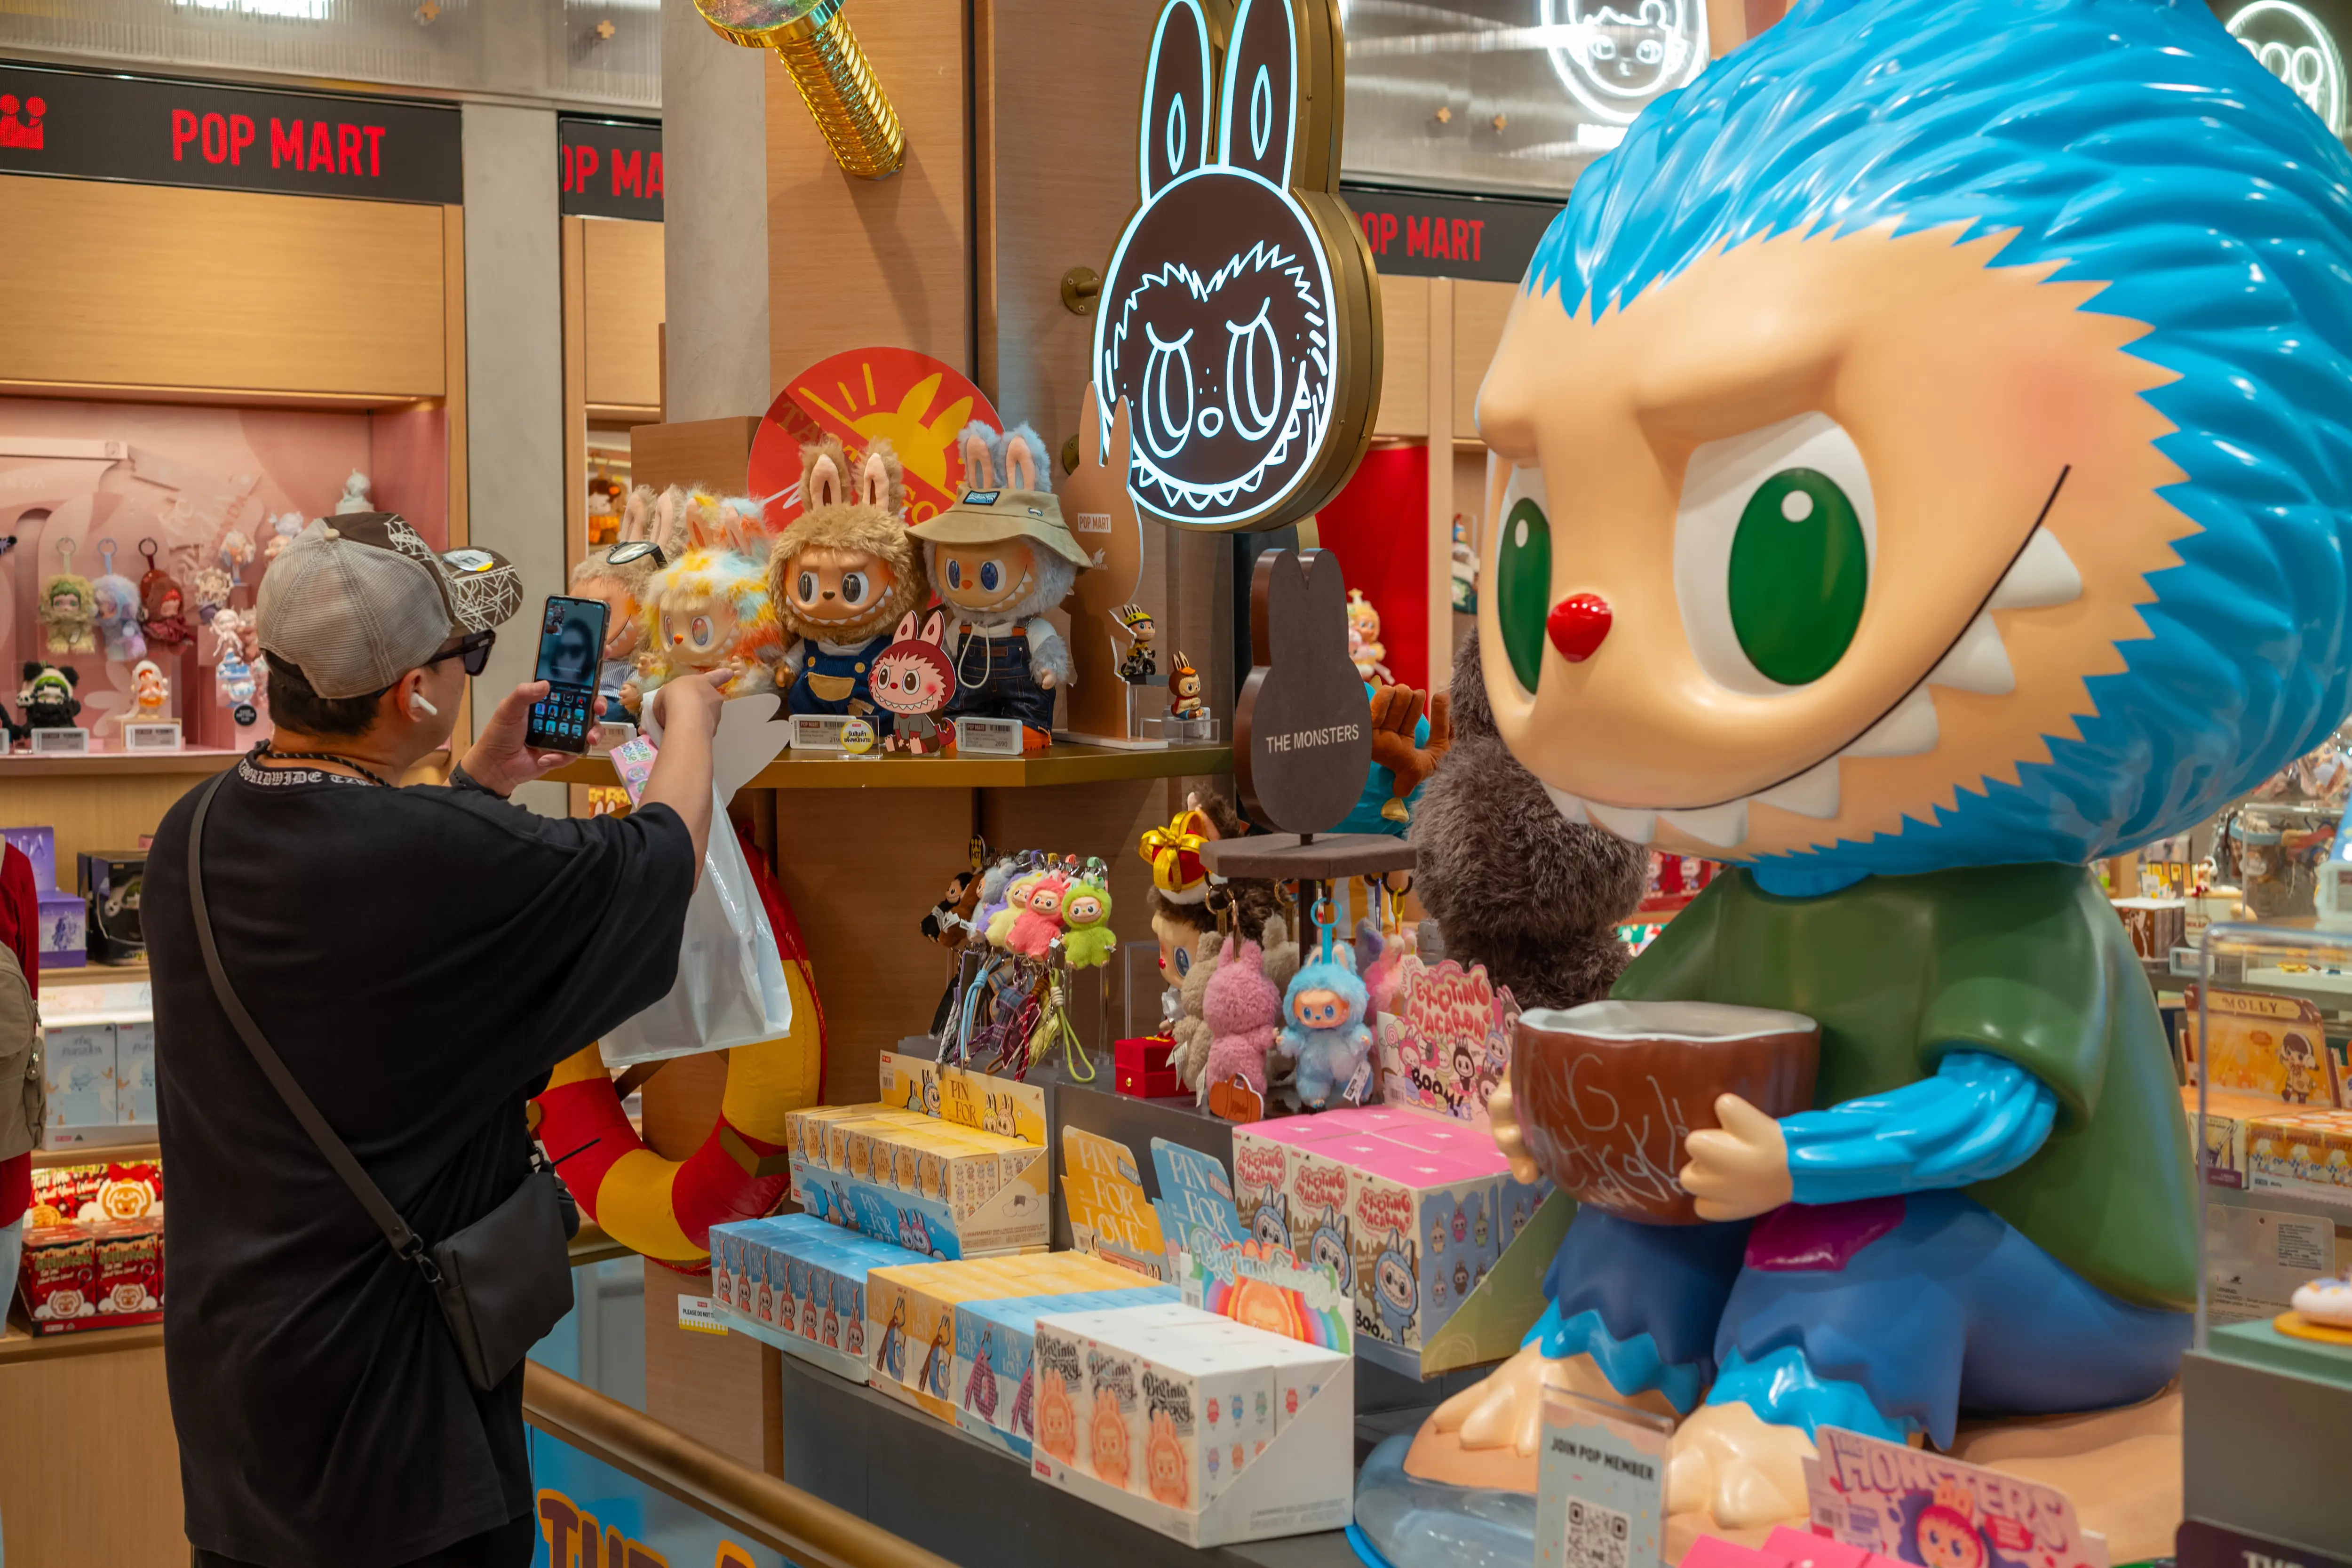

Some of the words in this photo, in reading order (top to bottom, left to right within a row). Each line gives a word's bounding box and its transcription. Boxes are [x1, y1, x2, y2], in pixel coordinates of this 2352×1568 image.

[172, 109, 255, 166] POP
[271, 118, 386, 177] MART
[1353, 211, 1398, 255] OP
[1407, 215, 1485, 261] MART
[1079, 516, 1091, 529] POP
[1092, 517, 1109, 530] MART
[1266, 734, 1291, 754] THE
[1294, 724, 1359, 749] MONSTERS
[972, 851, 980, 860] HOT
[1414, 974, 1489, 1012] EXCITING
[2222, 995, 2277, 1014] MOLLY
[1410, 1001, 1486, 1041] MACARON
[949, 1080, 969, 1101] PIN
[955, 1100, 983, 1129] FOR
[1077, 1138, 1117, 1178] PIN
[1167, 1149, 1208, 1194] PIN
[1242, 1151, 1283, 1170] EXCITING
[1238, 1164, 1279, 1188] MACARON
[1301, 1170, 1345, 1190] EXCITING
[858, 1192, 882, 1214] PIN
[1090, 1175, 1148, 1229] FOR
[1296, 1183, 1340, 1210] MACARON
[1363, 1191, 1411, 1213] EXCITING
[868, 1211, 899, 1241] FOR
[1182, 1188, 1234, 1241] FOR
[1359, 1204, 1406, 1234] MACARON
[1082, 1206, 1144, 1256] LOVE
[1036, 1332, 1060, 1360] Big
[1058, 1342, 1076, 1358] into
[1142, 1370, 1170, 1401] Big
[1167, 1383, 1188, 1399] into
[1551, 1436, 1577, 1457] JOIN
[1578, 1444, 1602, 1464] POP
[1603, 1451, 1655, 1481] MEMBER
